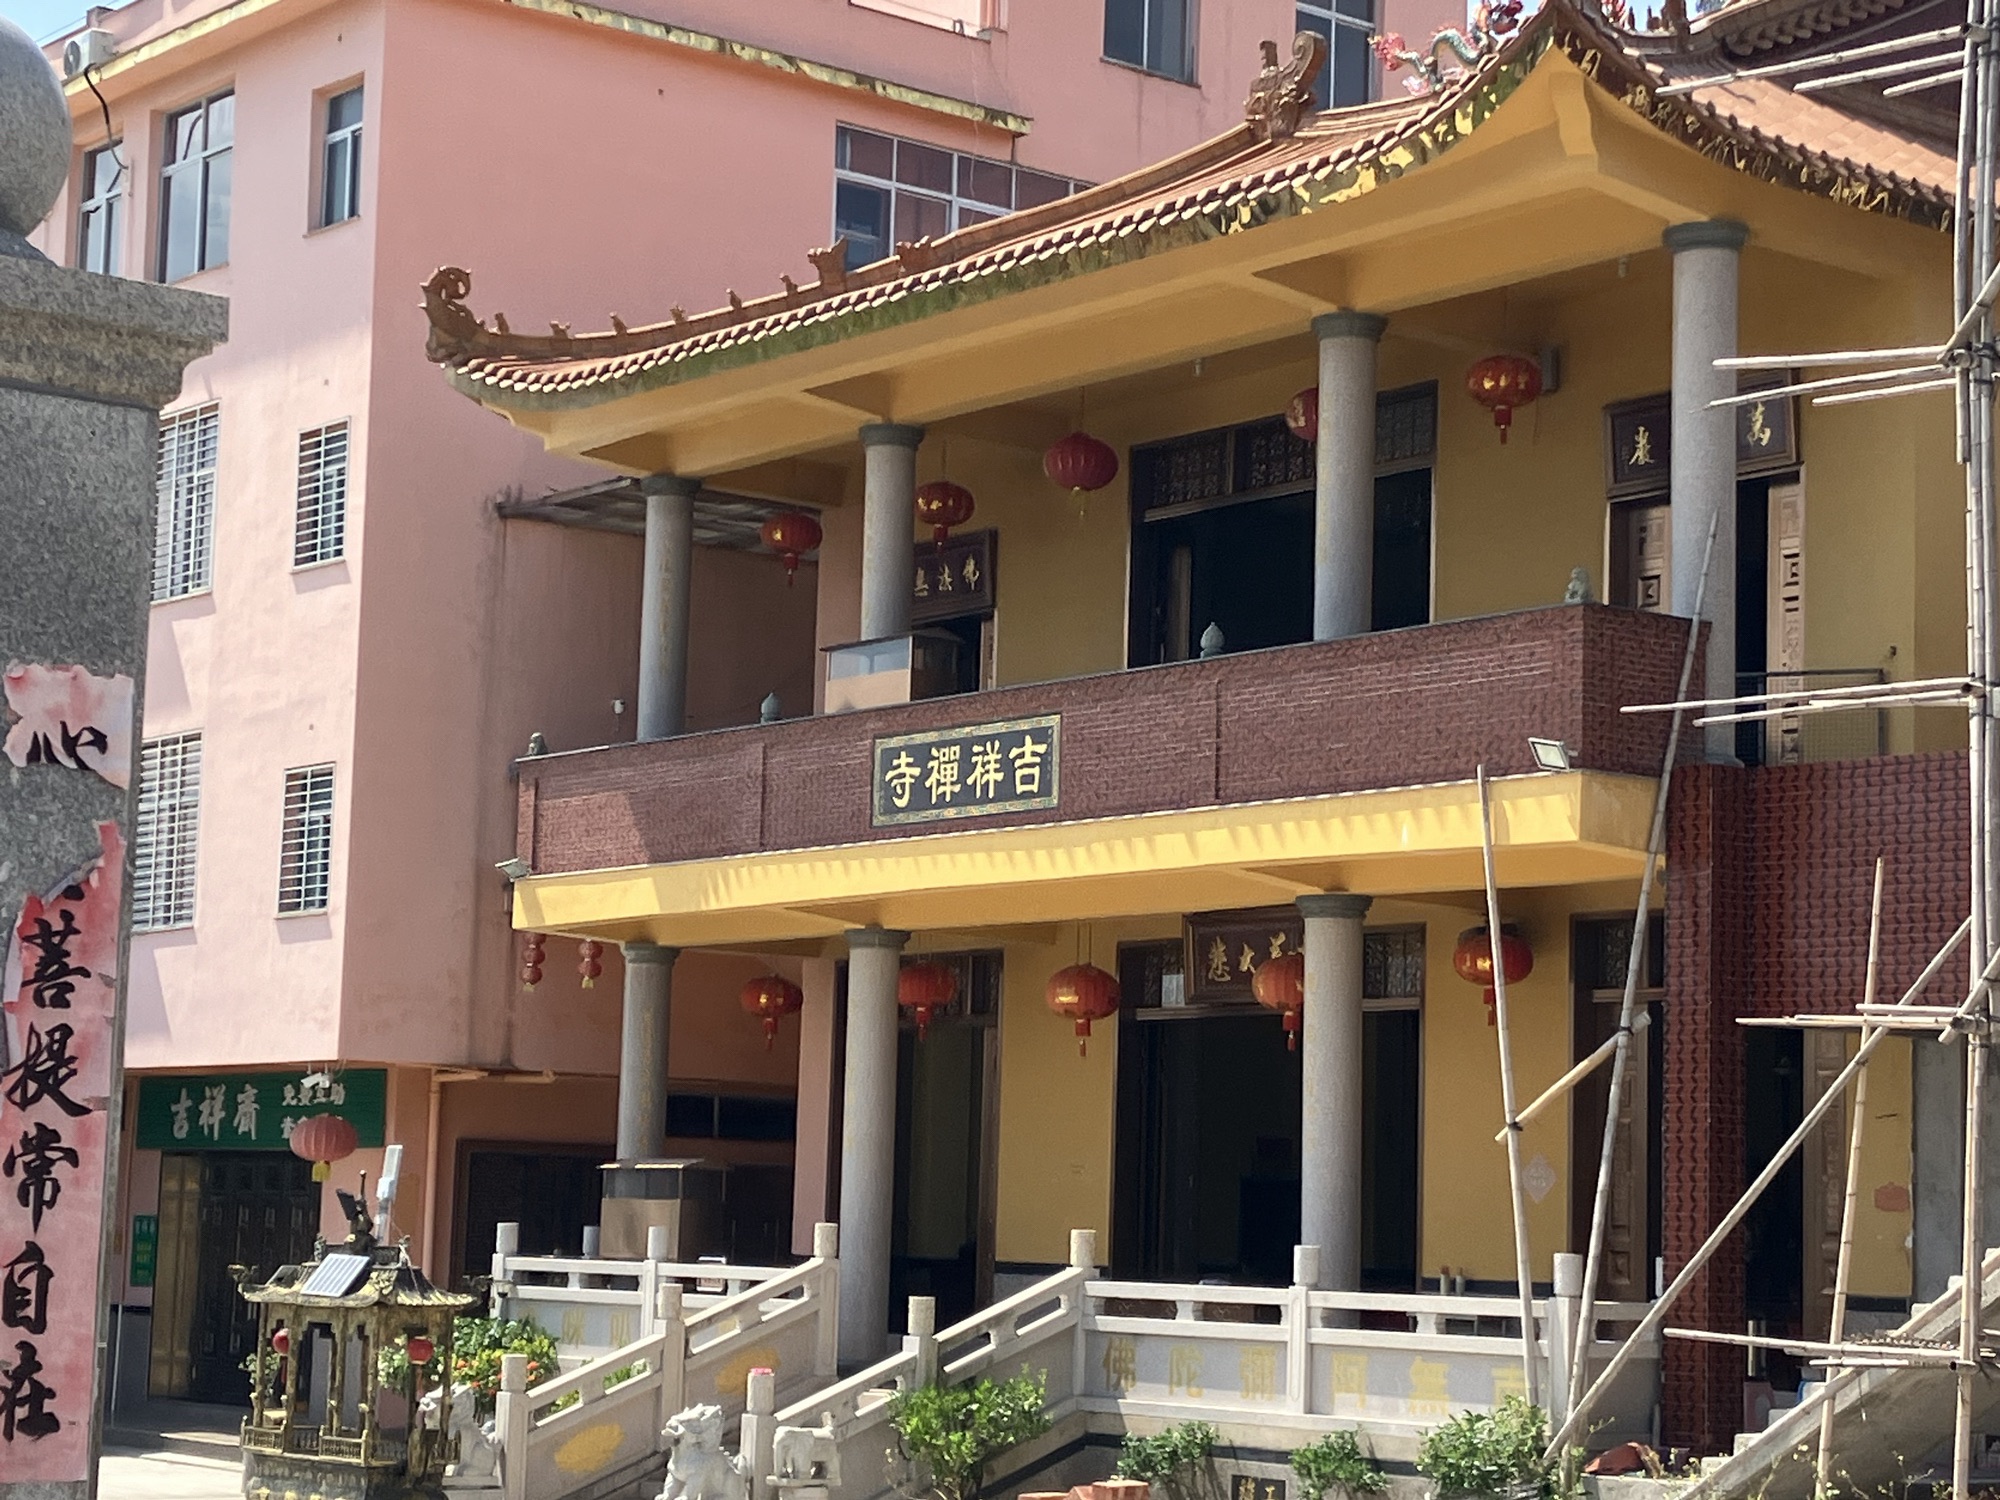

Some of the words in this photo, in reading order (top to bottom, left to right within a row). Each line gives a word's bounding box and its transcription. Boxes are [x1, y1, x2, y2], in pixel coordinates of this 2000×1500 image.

[884, 734, 1048, 809] 吉祥禪寺
[0, 909, 93, 1443] 菩提常自在
